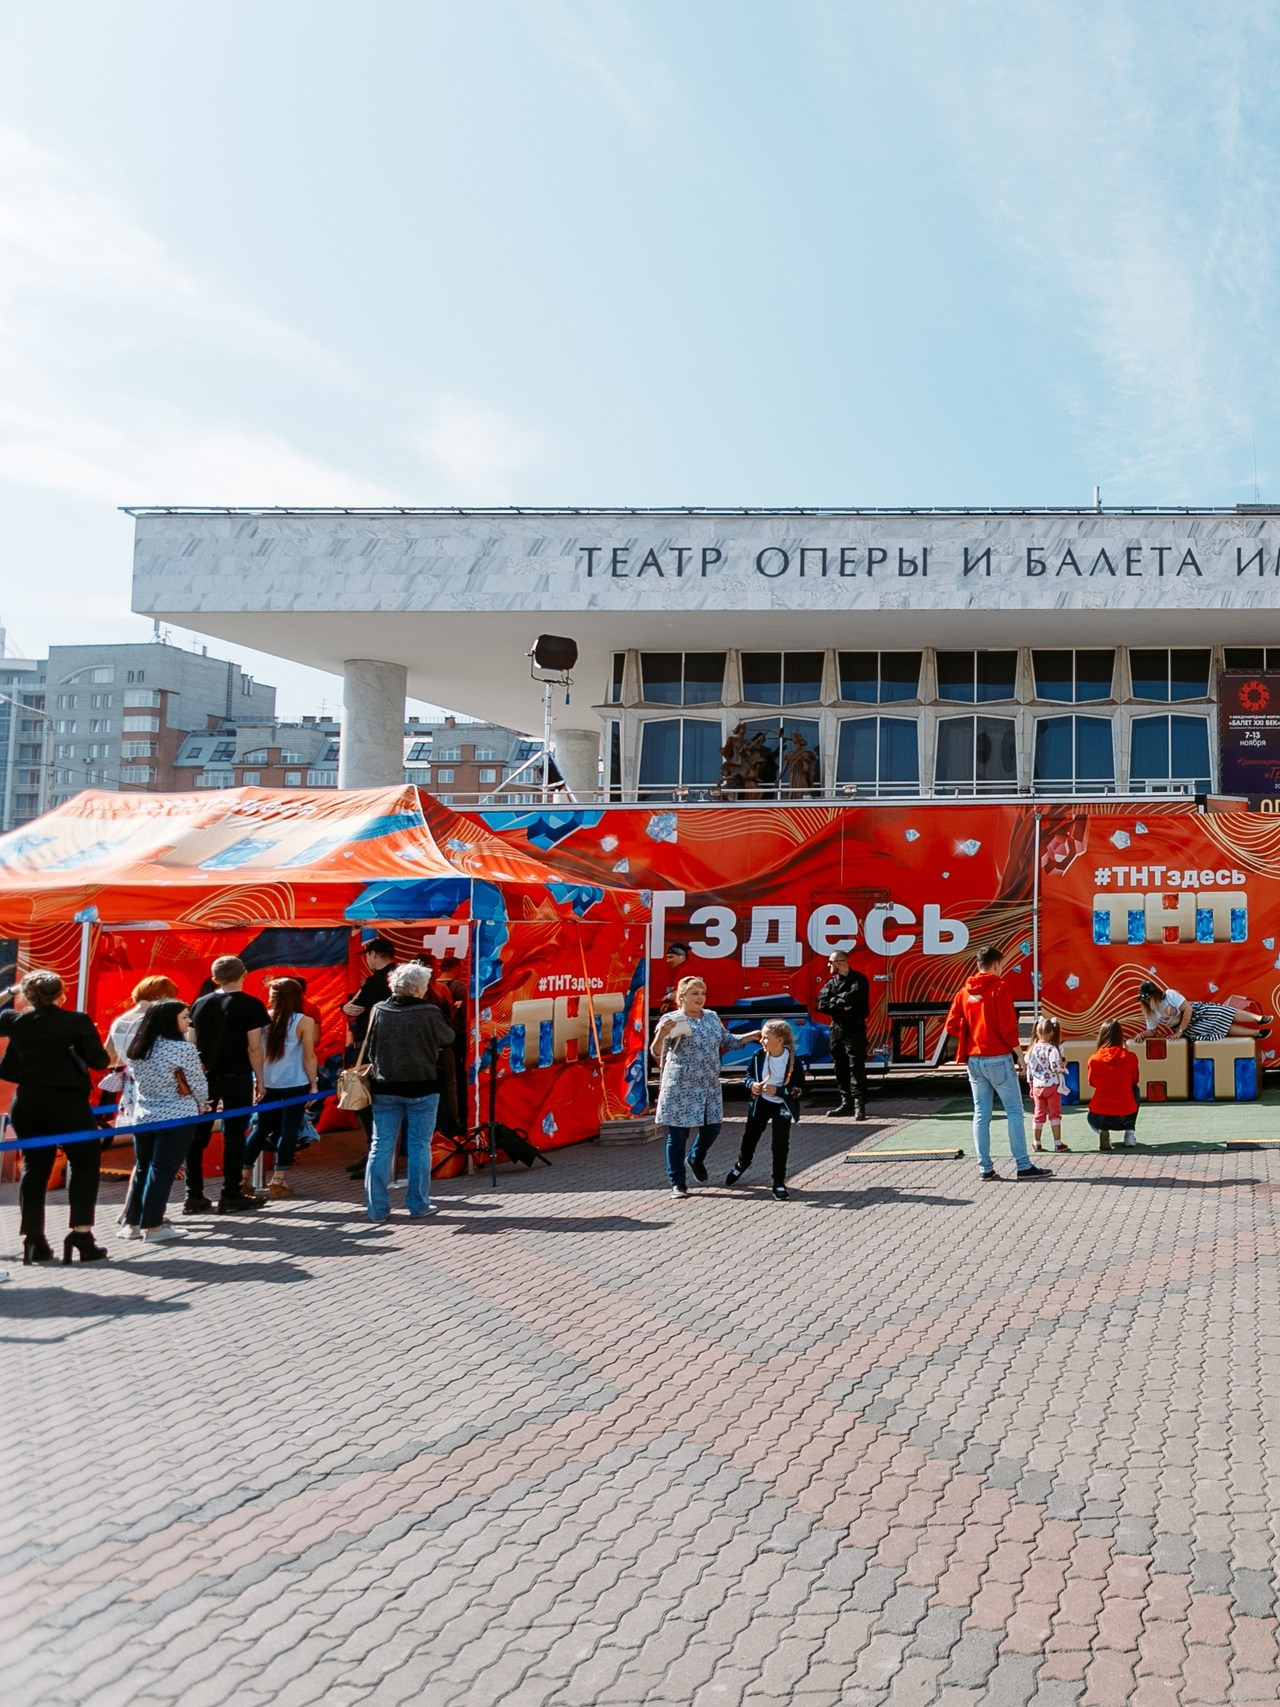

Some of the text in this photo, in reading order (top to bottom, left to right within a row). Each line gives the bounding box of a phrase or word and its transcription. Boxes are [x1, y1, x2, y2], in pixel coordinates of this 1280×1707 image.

[579, 547, 721, 578] ТЕАТР
[756, 546, 929, 578] ОПЕРЫ
[962, 547, 992, 578] И
[1026, 546, 1203, 578] БАЛЕТА
[1239, 739, 1267, 747] ноября
[1244, 731, 1261, 739] 7-13
[1094, 865, 1247, 888] #ТНТздесь
[1093, 891, 1248, 945] ТНТ
[538, 974, 604, 992] #ТНТздесь
[509, 992, 626, 1073] ТНТ
